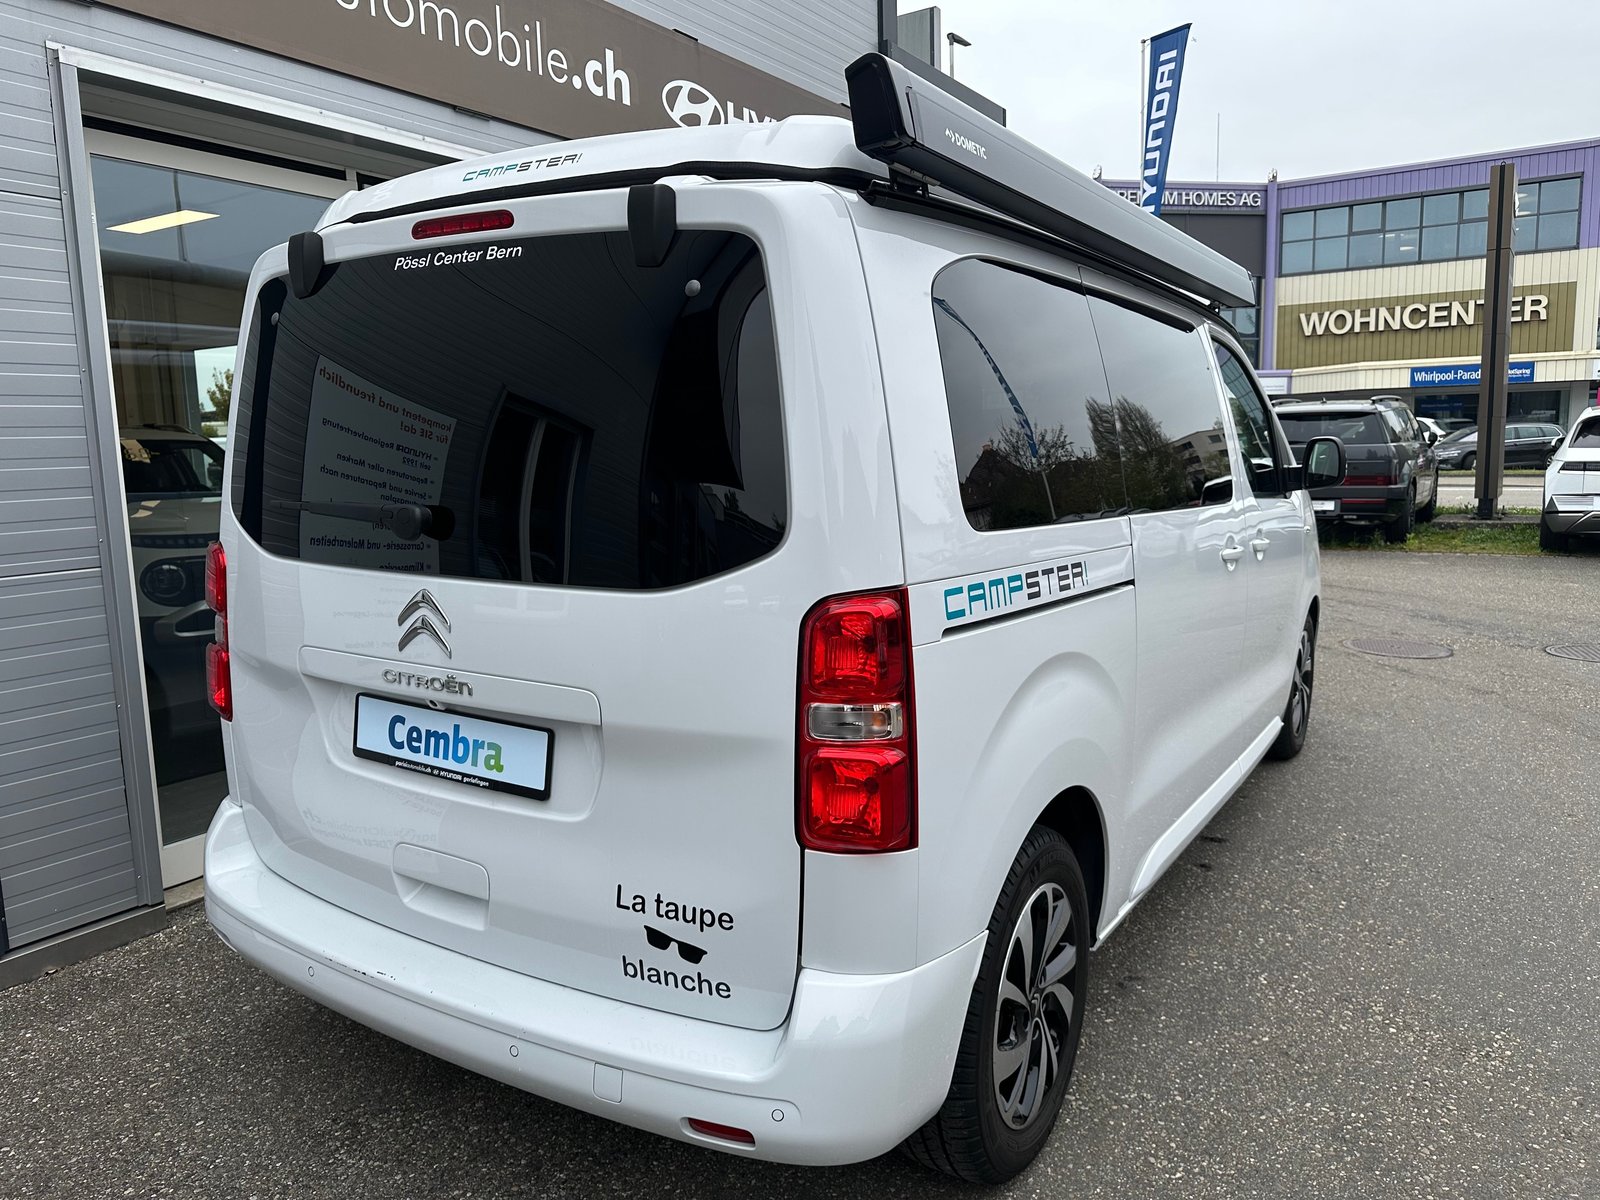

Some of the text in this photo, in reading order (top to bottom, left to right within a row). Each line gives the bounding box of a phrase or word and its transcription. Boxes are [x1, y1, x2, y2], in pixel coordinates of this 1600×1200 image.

[337, 0, 631, 106] omobile.ch
[462, 152, 583, 182] CAMPSTER!
[955, 132, 987, 160] DOMETIC
[1182, 191, 1237, 206] HOMES
[1239, 191, 1261, 207] AG
[394, 246, 522, 271] Pössl Center Bern
[1299, 294, 1549, 337] WOHNCENER
[944, 560, 1089, 621] CAMPSTER!
[388, 714, 505, 773] Cembra
[616, 884, 735, 933] La taupe
[622, 955, 732, 999] blanche
